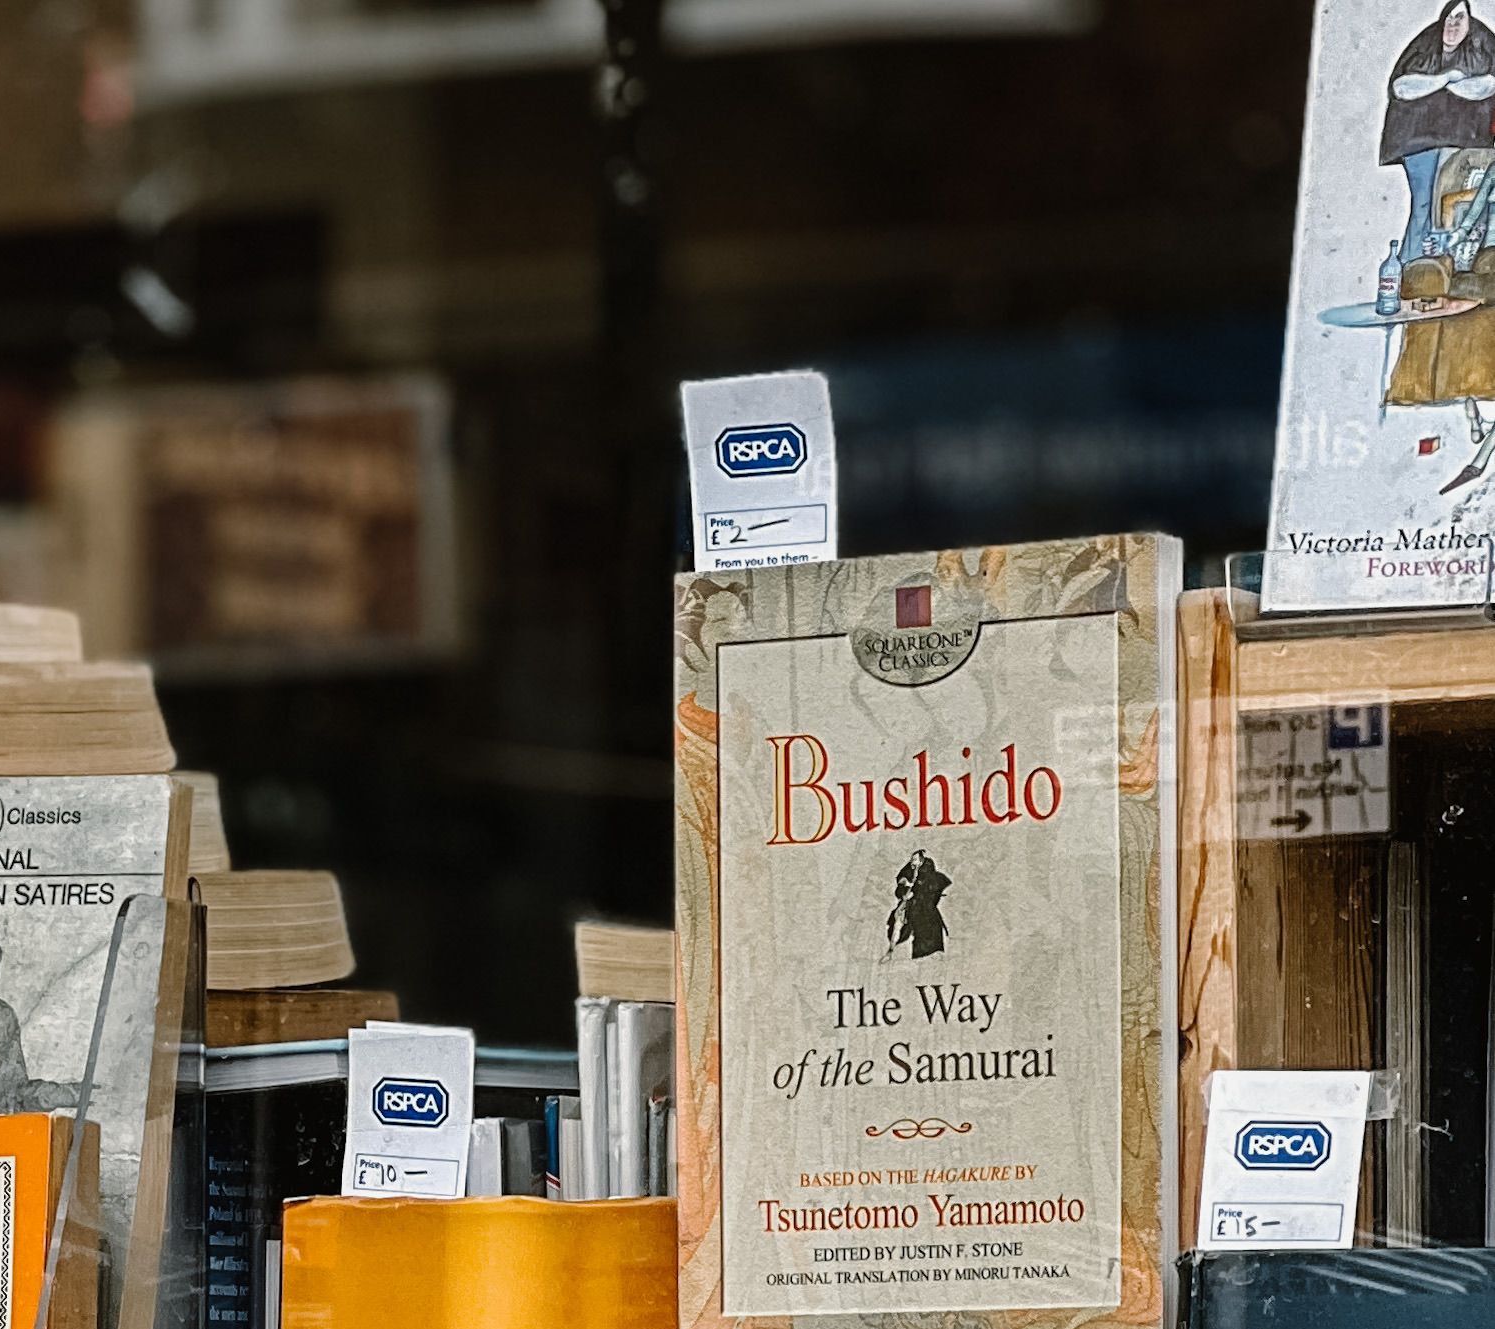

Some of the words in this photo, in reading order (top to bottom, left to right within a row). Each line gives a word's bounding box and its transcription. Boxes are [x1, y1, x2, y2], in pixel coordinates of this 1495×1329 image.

[728, 438, 796, 462] RSPCA
[1288, 529, 1384, 555] Victoria
[879, 651, 950, 672] CLASSICS
[765, 733, 1062, 846] Bushido
[6, 806, 82, 826] Classics
[13, 882, 116, 905] SATIRES
[827, 987, 902, 1029] The
[915, 982, 1003, 1033] Way
[773, 1048, 817, 1100] of
[820, 1048, 874, 1088] the
[887, 1033, 1057, 1086] Samurai
[1248, 1134, 1318, 1156] RSPCA
[758, 1199, 919, 1233] Tsunetomo
[927, 1193, 1085, 1227] Yamamoto
[766, 1269, 832, 1287] ORIGINAL
[834, 1267, 929, 1285] TRANSLATION
[932, 1266, 952, 1283] BY
[954, 1264, 1011, 1283] MINORU
[1013, 1263, 1071, 1281] TANAKA
